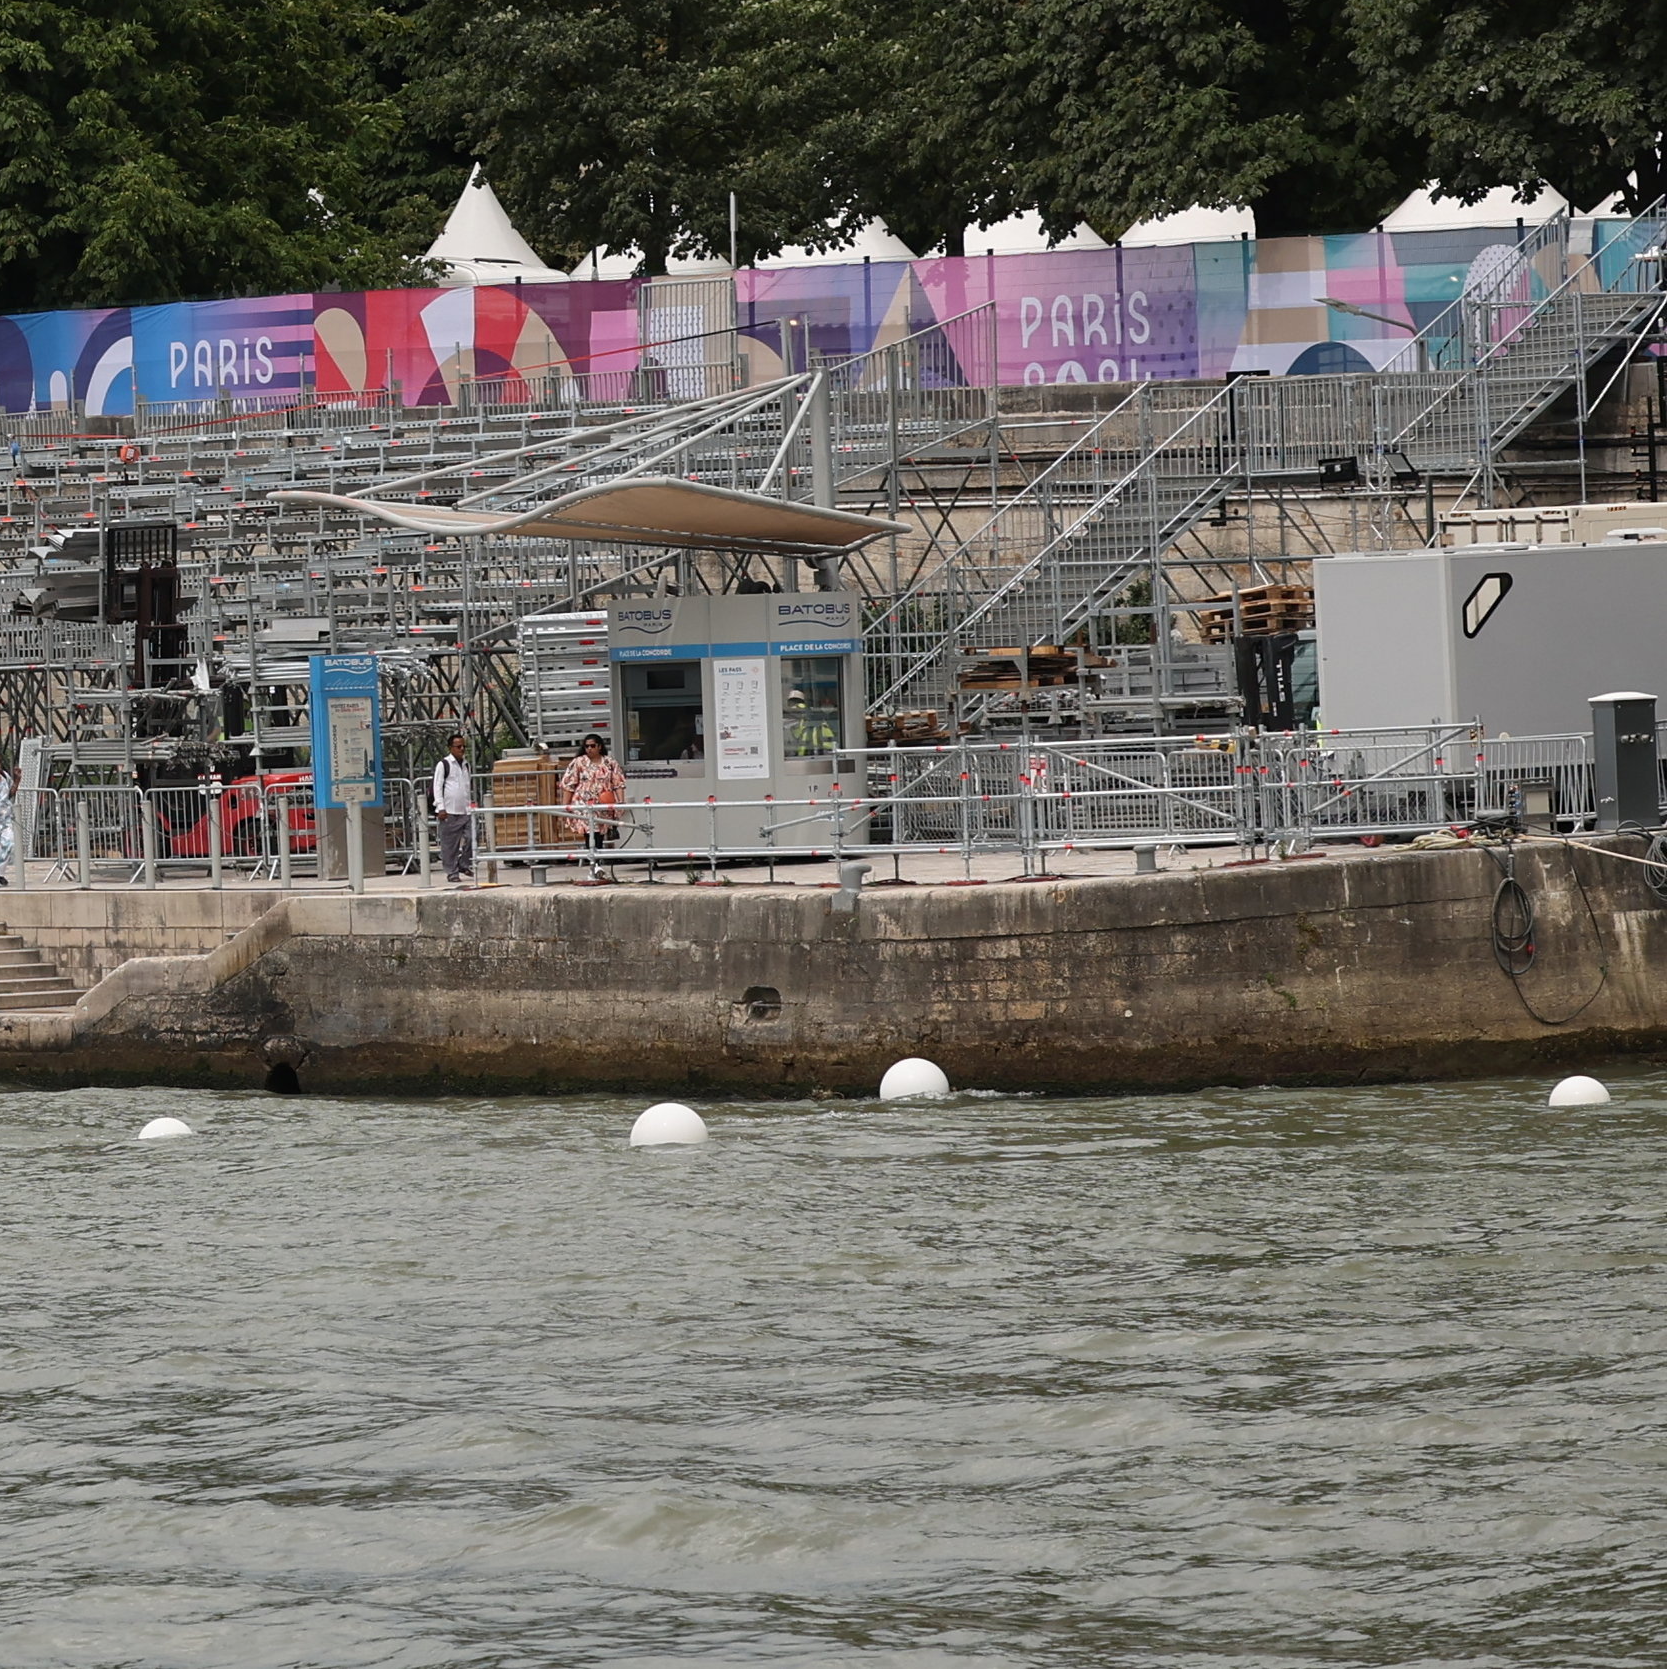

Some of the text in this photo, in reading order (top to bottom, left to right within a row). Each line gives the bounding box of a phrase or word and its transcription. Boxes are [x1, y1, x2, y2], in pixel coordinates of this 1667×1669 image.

[618, 609, 672, 621] BATOBUS
[778, 603, 850, 615] BATOBUS
[780, 644, 803, 652] PLACE
[324, 658, 373, 667] BATOBUS
[1276, 659, 1286, 702] STILL
